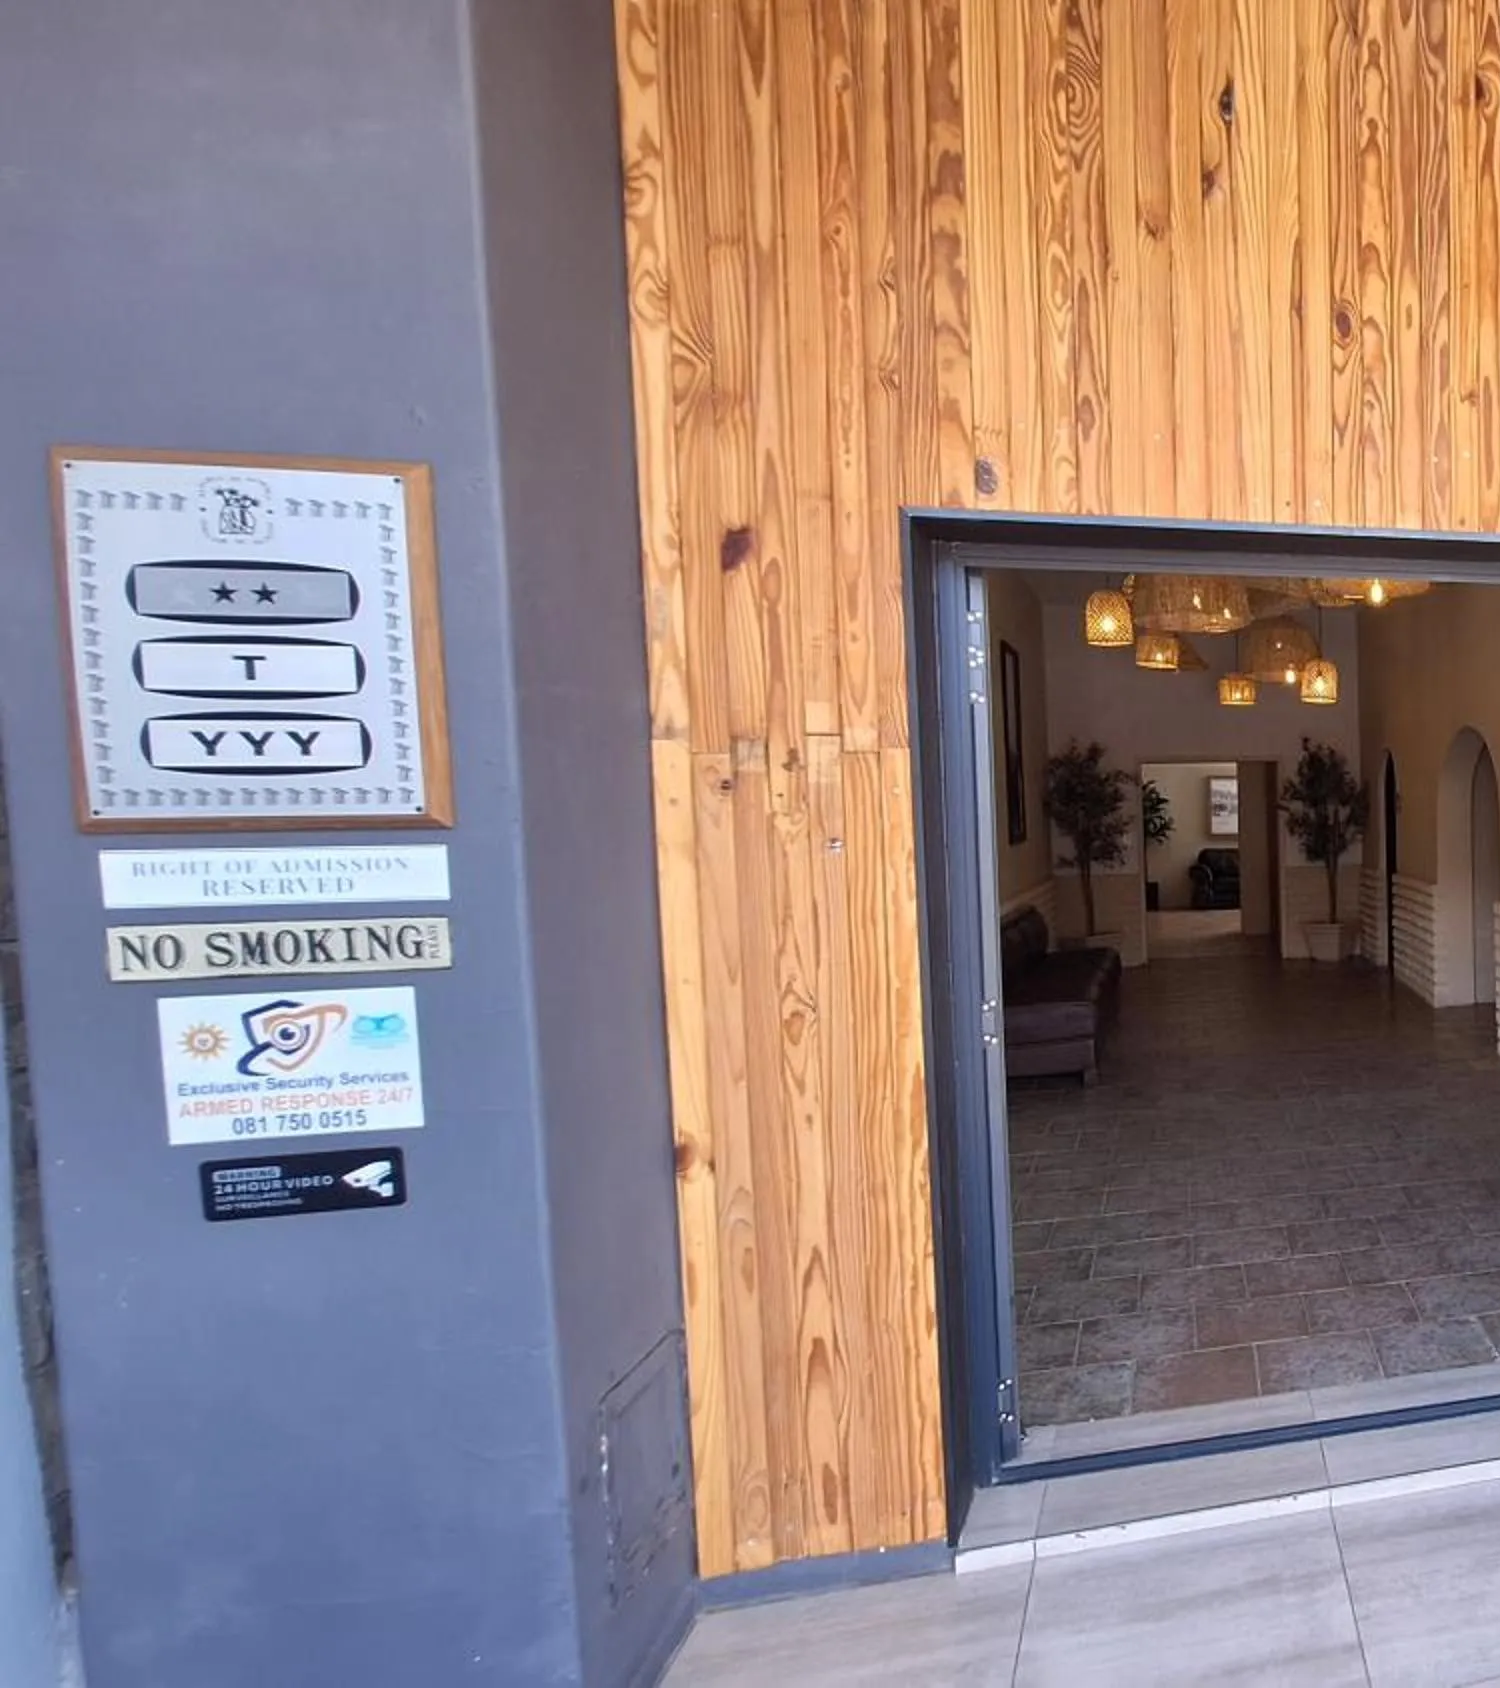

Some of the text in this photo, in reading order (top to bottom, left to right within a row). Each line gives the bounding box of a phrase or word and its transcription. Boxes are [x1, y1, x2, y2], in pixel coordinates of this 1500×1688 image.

[232, 655, 267, 681] T
[132, 856, 411, 878] RIGHT OF ADMISSION
[203, 877, 355, 897] RESERVED
[119, 934, 184, 971] NO
[205, 925, 424, 968] SMOKING
[178, 1070, 410, 1097] Exclusive Security Services
[179, 1087, 413, 1118] ARMED RESPONSE 24/7
[232, 1109, 368, 1135] 081 750 0515
[214, 1175, 334, 1195] 24 HOUR VIDEO
[217, 1167, 276, 1181] WARNING
